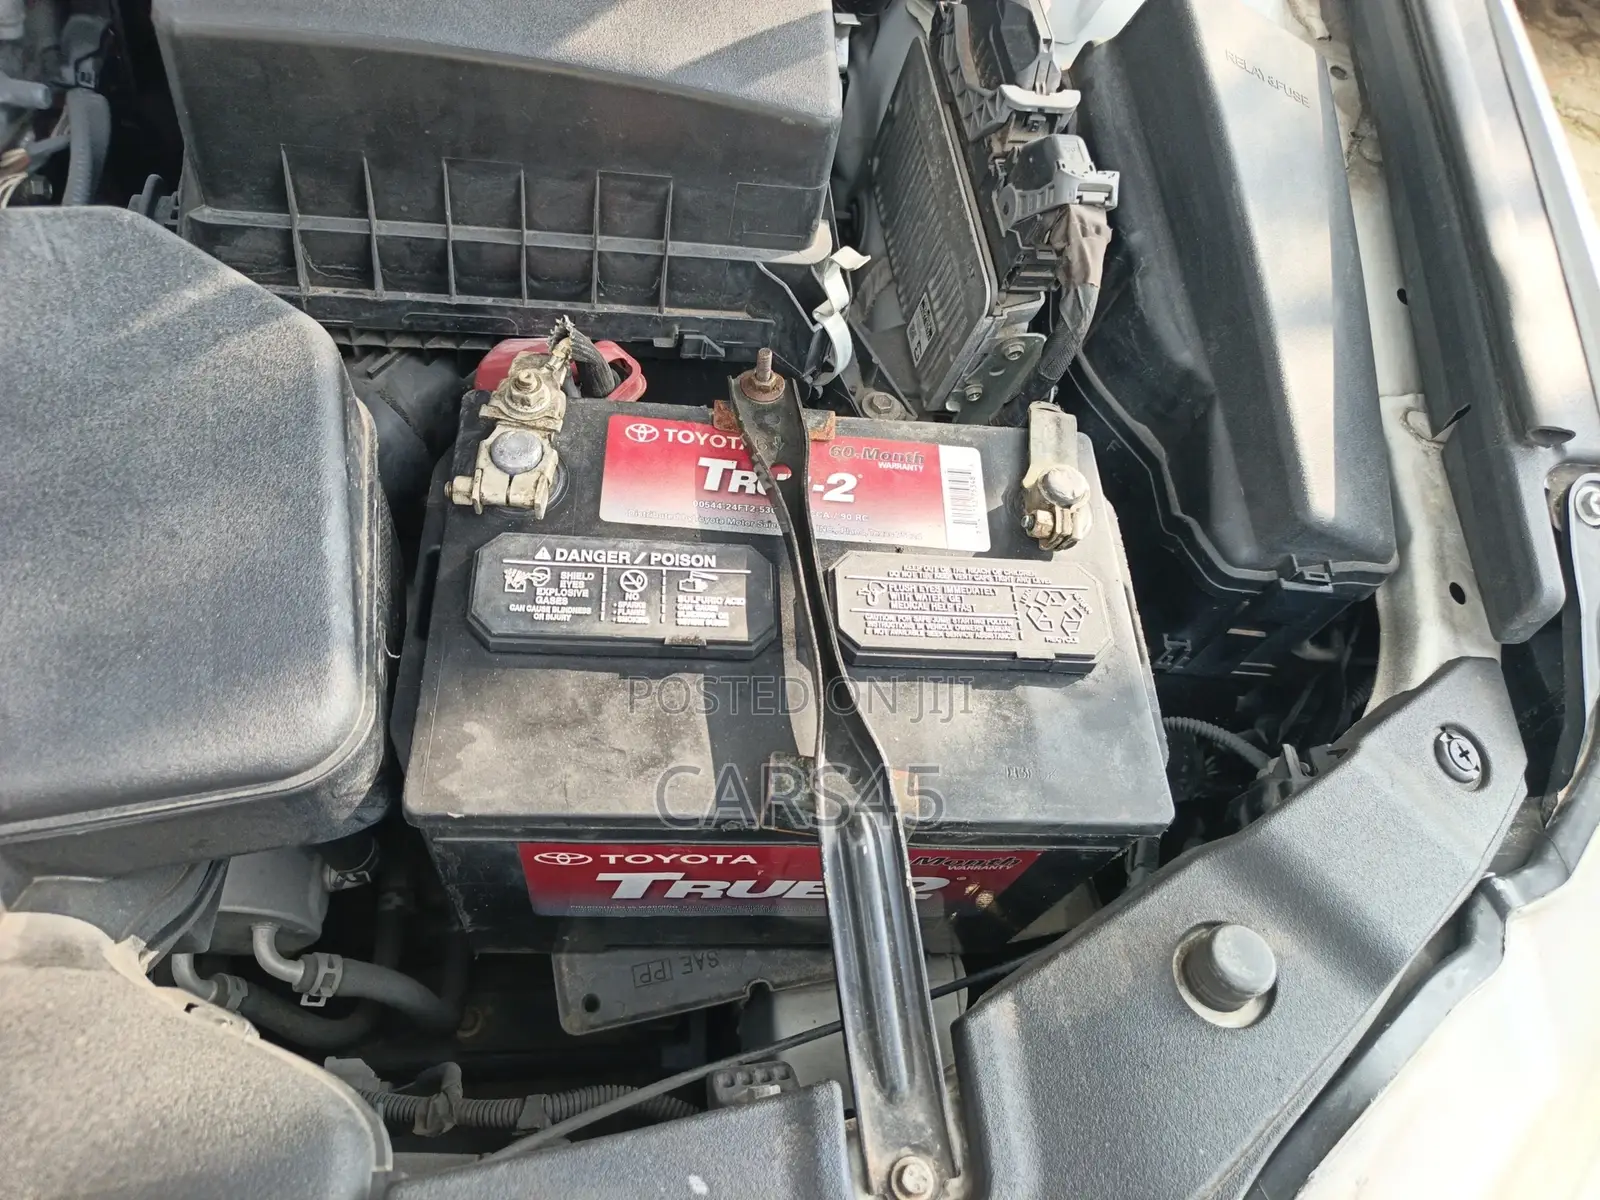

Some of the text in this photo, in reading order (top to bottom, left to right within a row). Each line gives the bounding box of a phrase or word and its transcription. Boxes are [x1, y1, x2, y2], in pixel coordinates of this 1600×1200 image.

[878, 461, 925, 473] WARRANTY
[727, 516, 755, 527] Motor
[555, 548, 631, 564] DANGER
[650, 552, 717, 568] POISON
[560, 571, 594, 581] SHIELD
[560, 580, 585, 589] EYES
[888, 583, 997, 597] FLUSH EYES IMMEDIATELY
[536, 588, 589, 597] EXPLOSIVE
[625, 592, 640, 601] NO
[888, 592, 911, 602] WITH
[946, 595, 964, 604] GET
[535, 596, 568, 605] GASES
[509, 604, 525, 612] CAN
[526, 605, 551, 613] CAUSE
[889, 601, 976, 613] MEDICAL HELP FAST
[600, 854, 758, 865] TOYOTA
[681, 949, 720, 975] SAE
